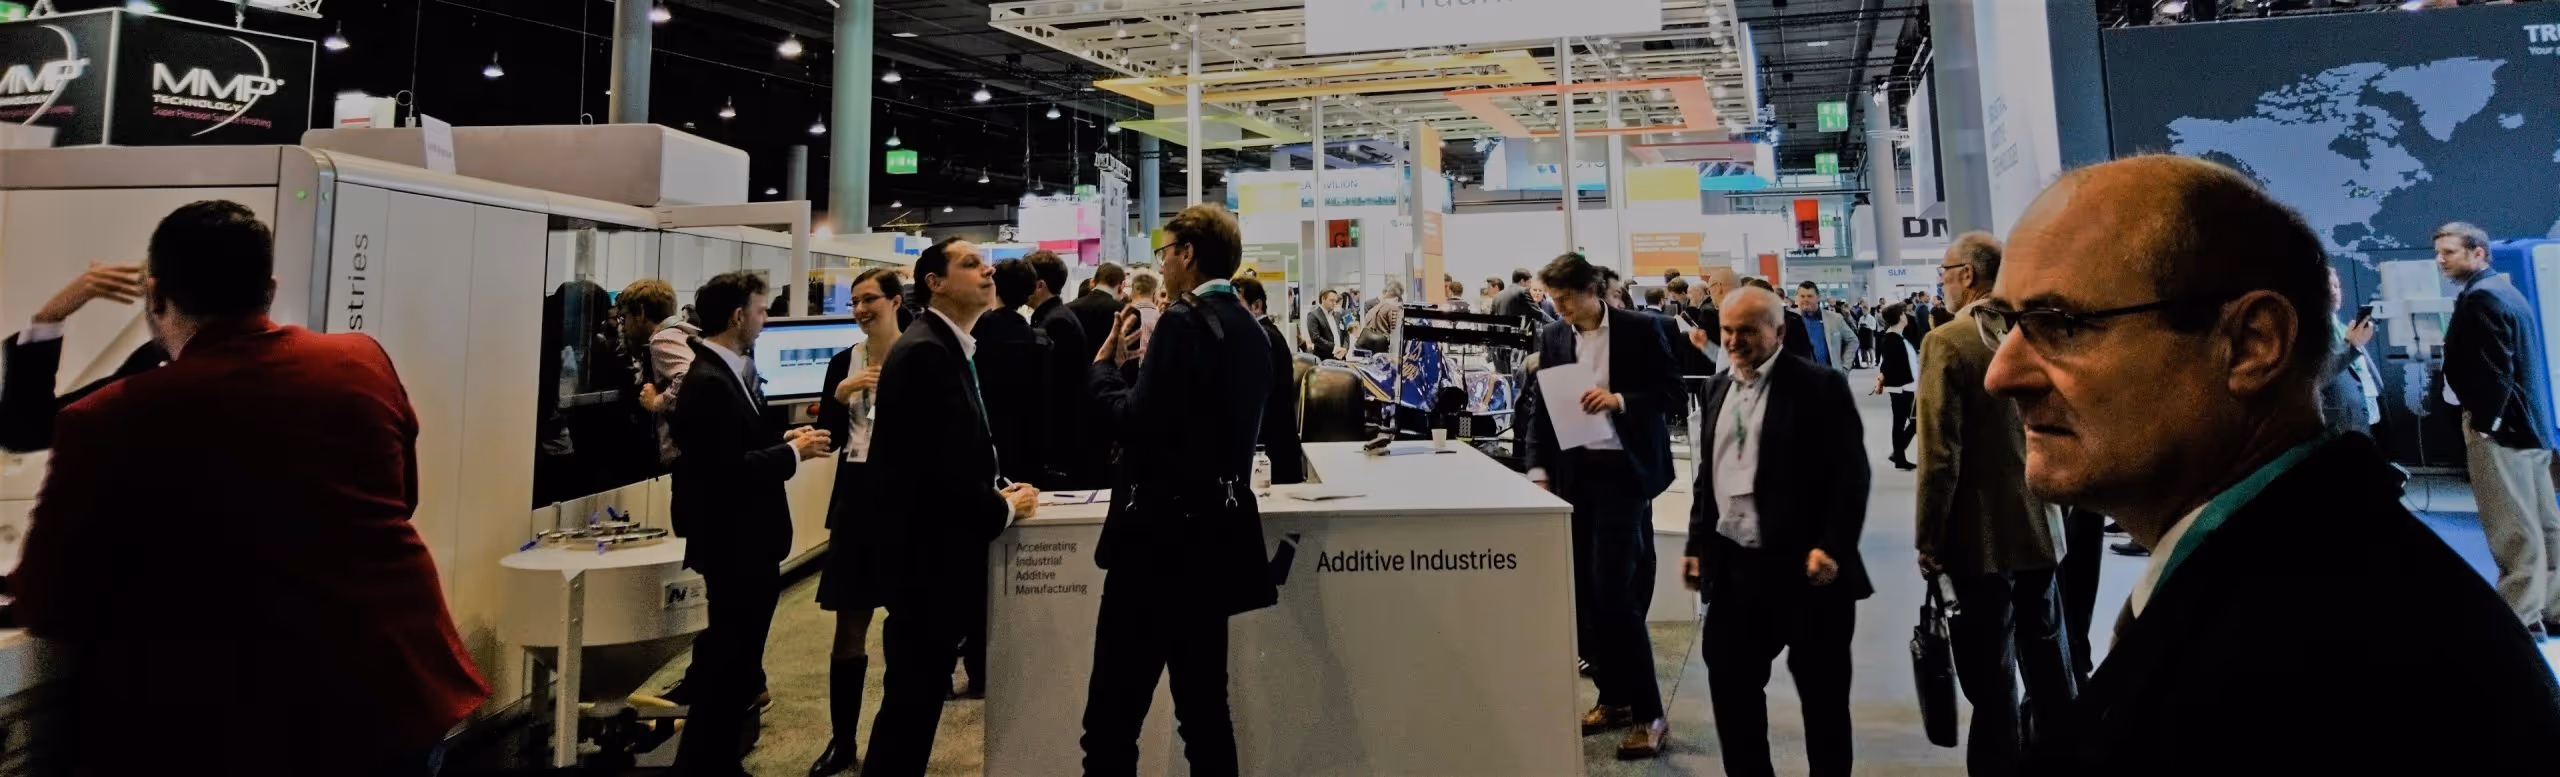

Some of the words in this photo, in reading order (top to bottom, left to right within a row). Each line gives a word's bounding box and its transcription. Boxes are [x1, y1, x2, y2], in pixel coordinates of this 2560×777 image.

[2523, 24, 2560, 43] TR
[152, 62, 277, 102] MMP
[152, 94, 243, 112] TECHNOLOGY
[152, 106, 176, 117] Super
[1887, 268, 1906, 276] SLM
[347, 233, 369, 331] stries
[1016, 542, 1078, 552] Accelerating
[1016, 556, 1062, 566] Industrial
[1316, 549, 1404, 573] Additive
[1410, 548, 1517, 571] Industries
[1016, 570, 1056, 580] Additive
[1016, 583, 1088, 595] Manufacturing
